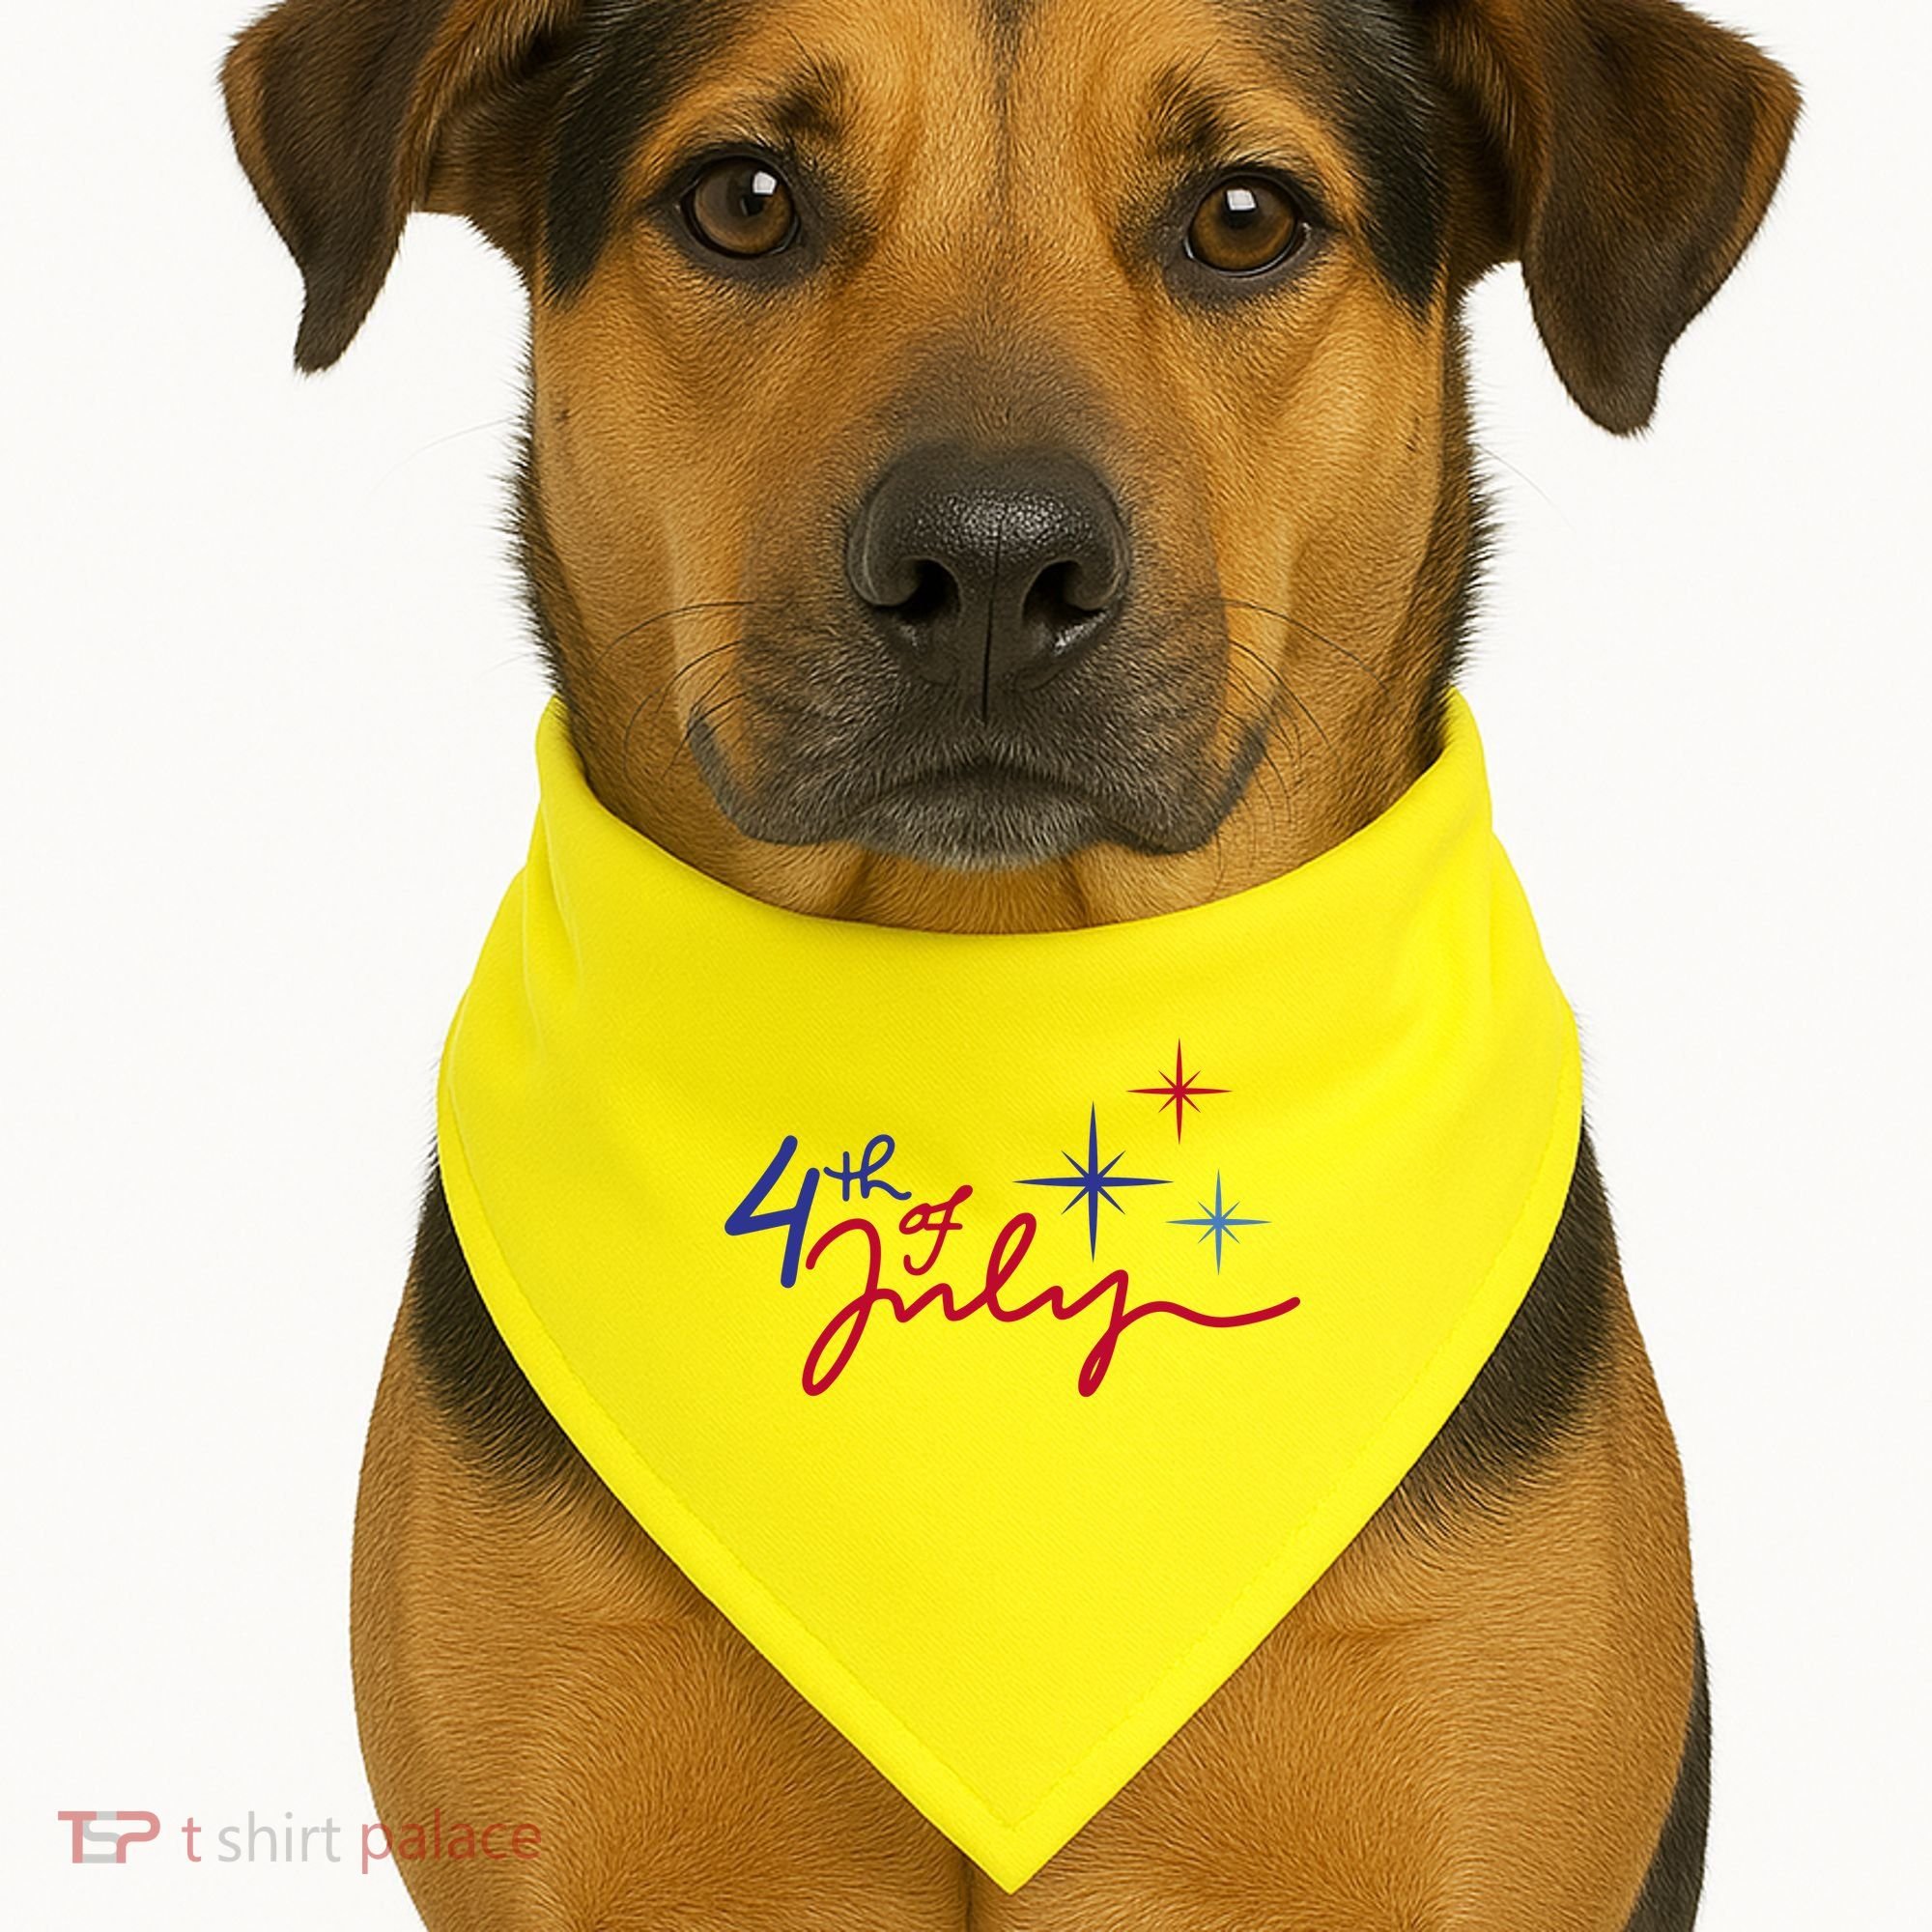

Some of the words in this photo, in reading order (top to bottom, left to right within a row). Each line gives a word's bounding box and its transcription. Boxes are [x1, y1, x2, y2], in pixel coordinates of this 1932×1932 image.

[724, 1134, 912, 1288] 4th
[899, 1185, 973, 1275] of
[802, 1212, 1300, 1397] July
